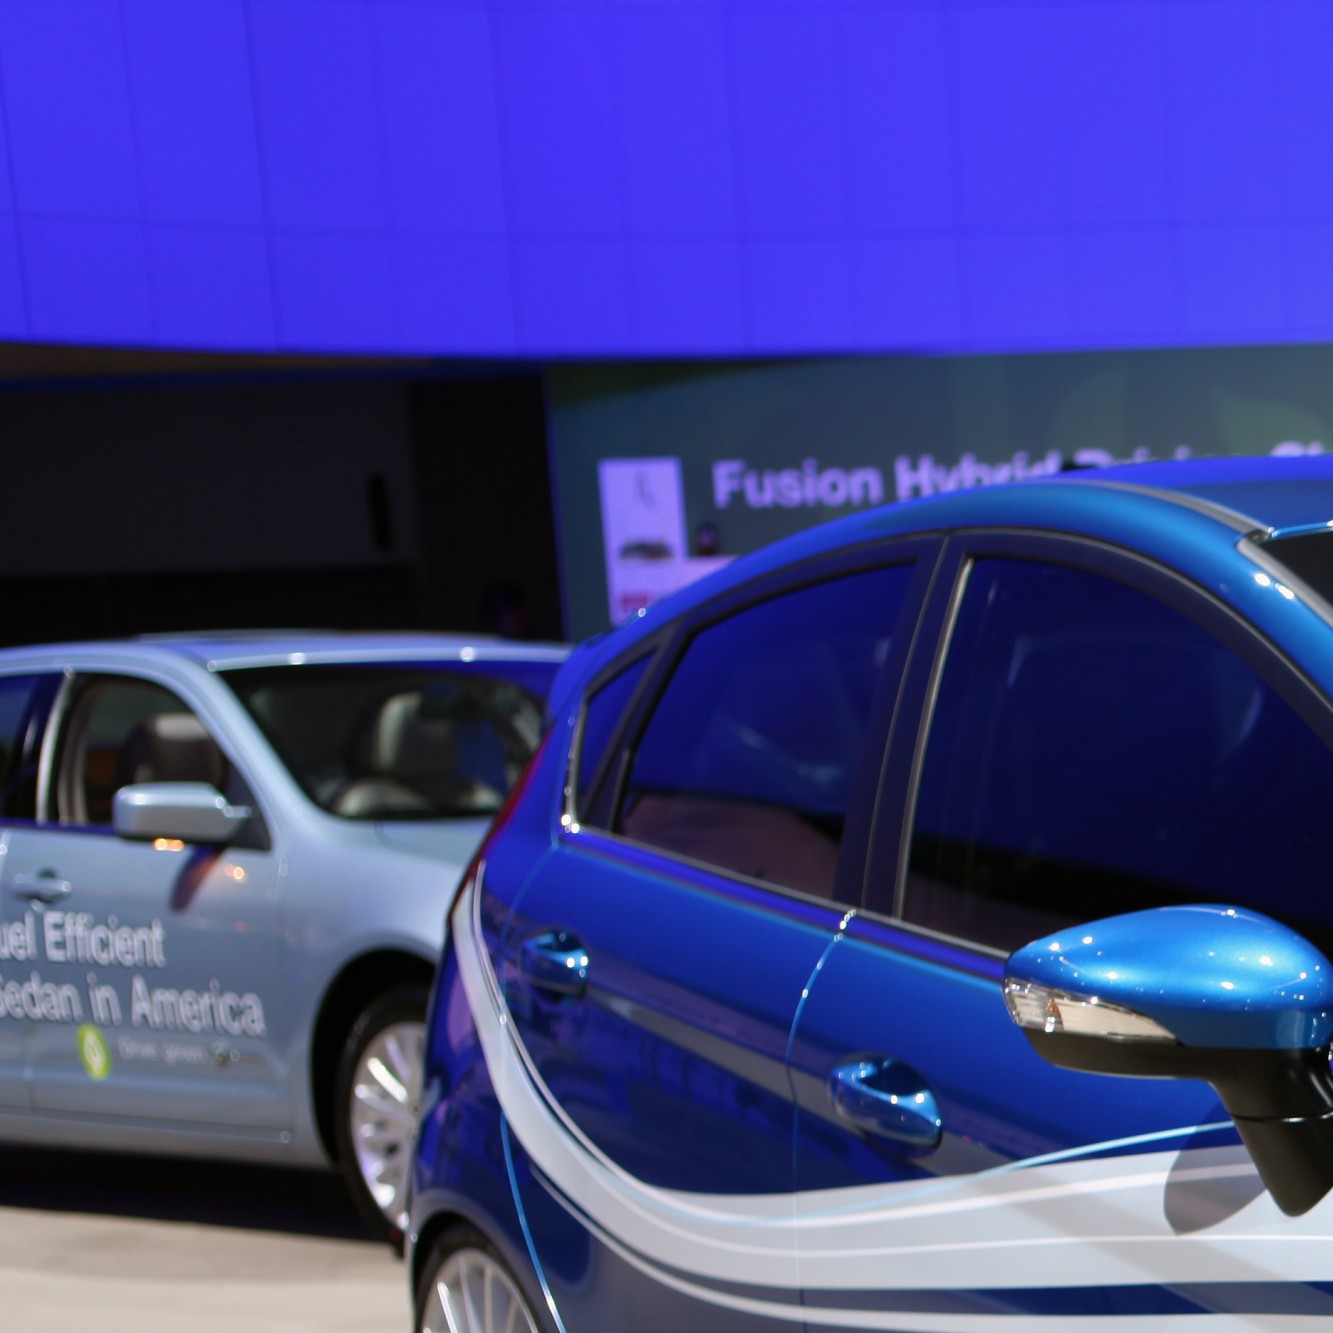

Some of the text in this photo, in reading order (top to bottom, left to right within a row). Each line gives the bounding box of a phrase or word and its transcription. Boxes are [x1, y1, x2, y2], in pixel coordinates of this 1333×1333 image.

[711, 456, 884, 509] Fusion
[43, 909, 167, 968] Efficient
[87, 971, 123, 1026] in
[131, 974, 268, 1037] America
